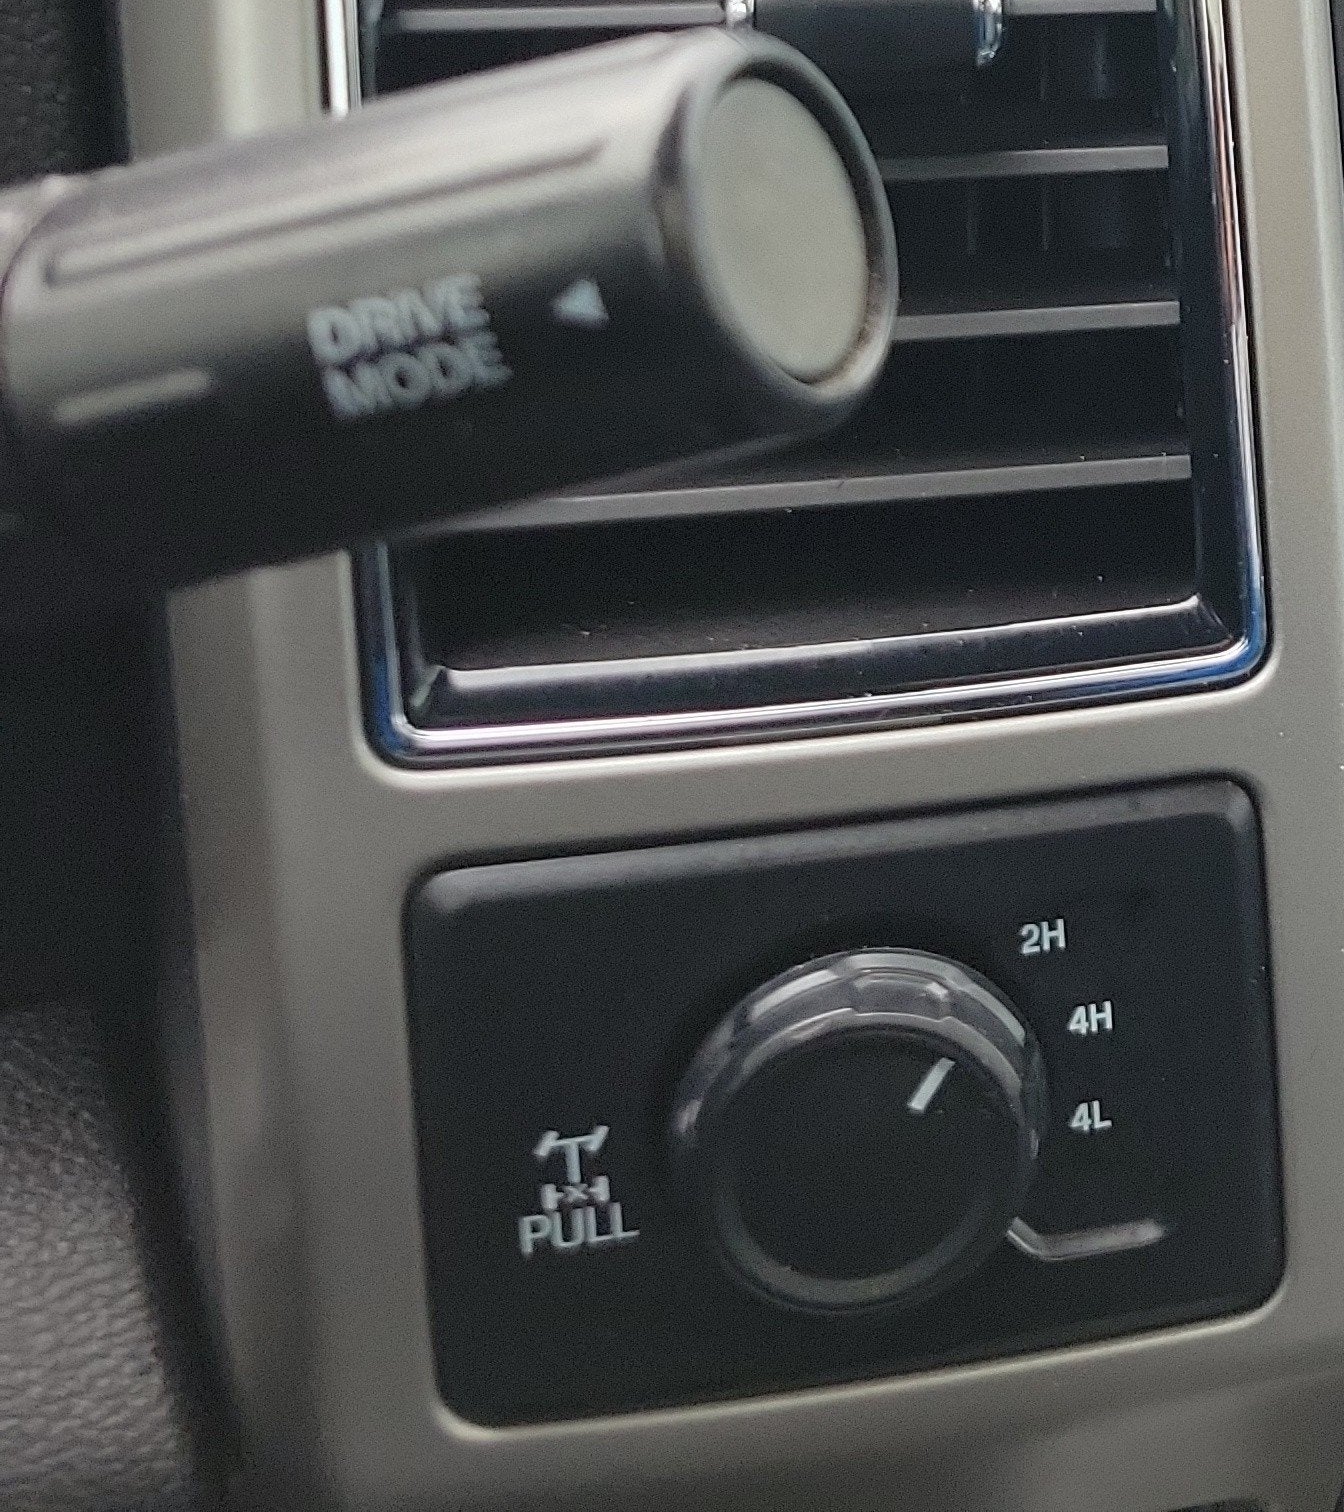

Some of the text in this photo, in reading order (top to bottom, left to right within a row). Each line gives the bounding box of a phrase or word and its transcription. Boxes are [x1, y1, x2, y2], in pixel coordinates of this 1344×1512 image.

[307, 272, 490, 366] DRIVE
[322, 328, 514, 421] MODE
[1019, 918, 1067, 957] 2H
[1068, 1000, 1114, 1036] 4H
[1069, 1100, 1113, 1133] 4L
[518, 1208, 641, 1256] PULL
